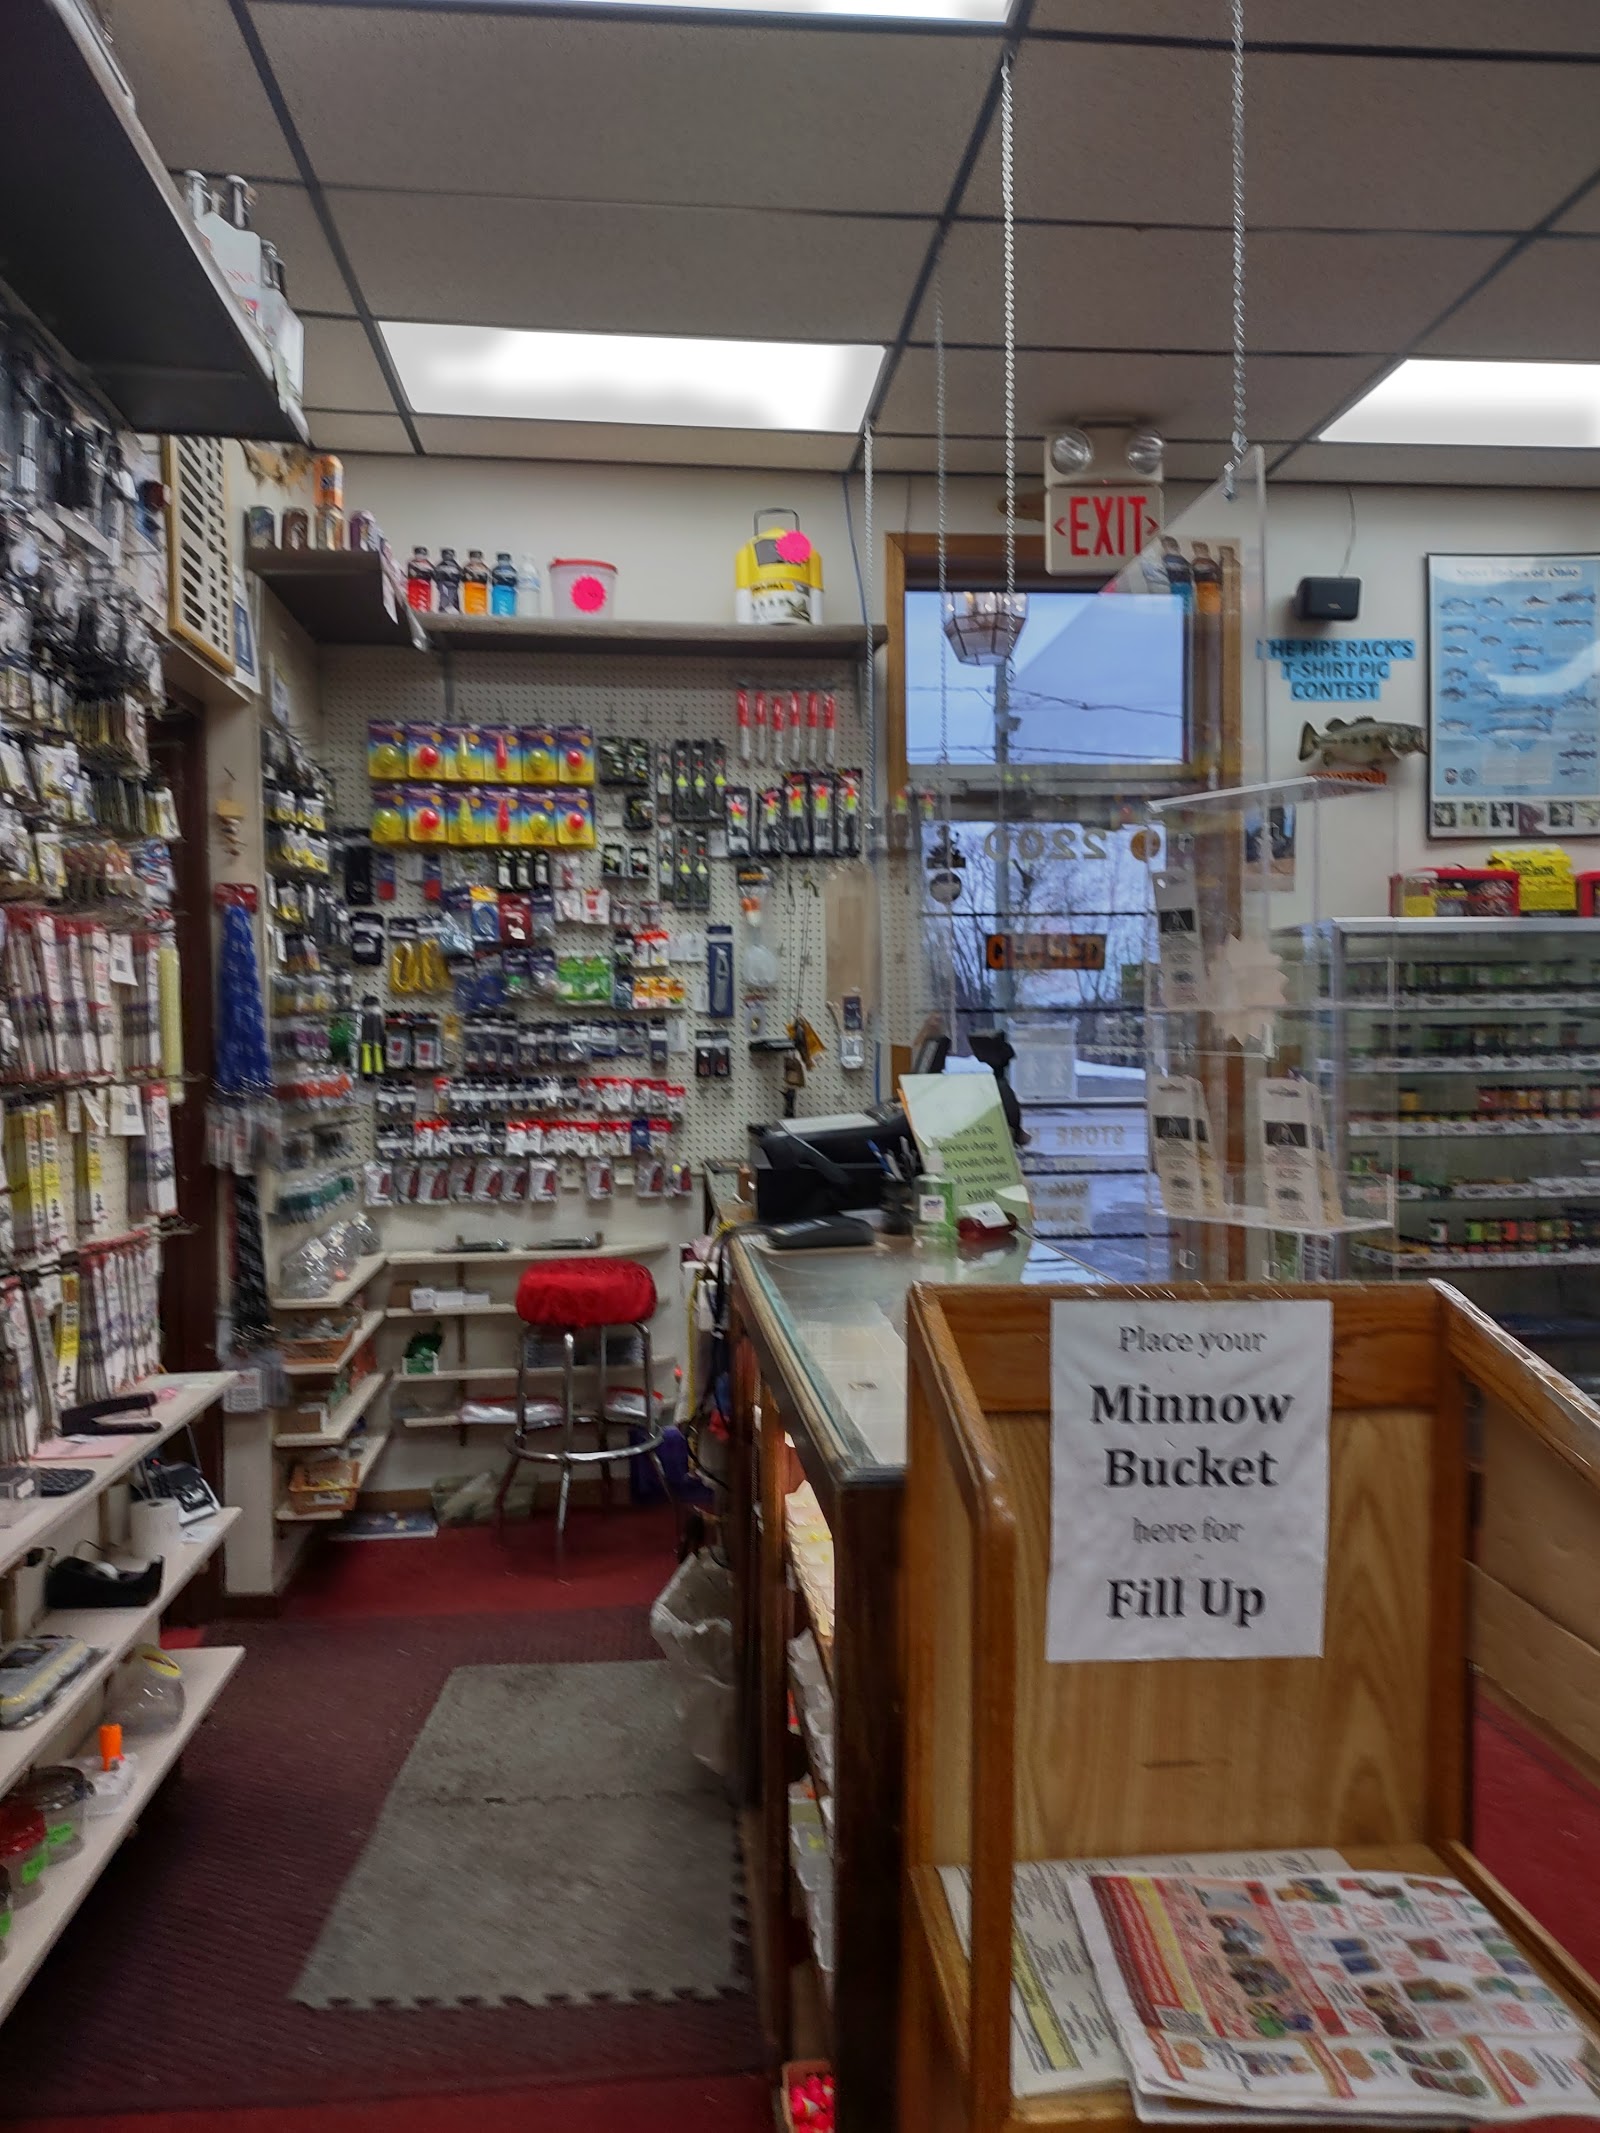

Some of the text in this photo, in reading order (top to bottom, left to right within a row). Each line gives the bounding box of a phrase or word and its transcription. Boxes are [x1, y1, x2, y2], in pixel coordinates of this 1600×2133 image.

[1070, 496, 1146, 556] EXIT
[1302, 639, 1343, 658] PIPE
[1346, 639, 1414, 658] RACK'S
[1282, 661, 1390, 680] T-SHIRT PIC
[1292, 681, 1380, 700] CONTEST
[1118, 1325, 1266, 1360] Place your
[1089, 1384, 1295, 1425] Minnow
[1103, 1446, 1279, 1488] Bucket
[1132, 1515, 1245, 1544] here for
[1106, 1576, 1266, 1629] Fill Up
